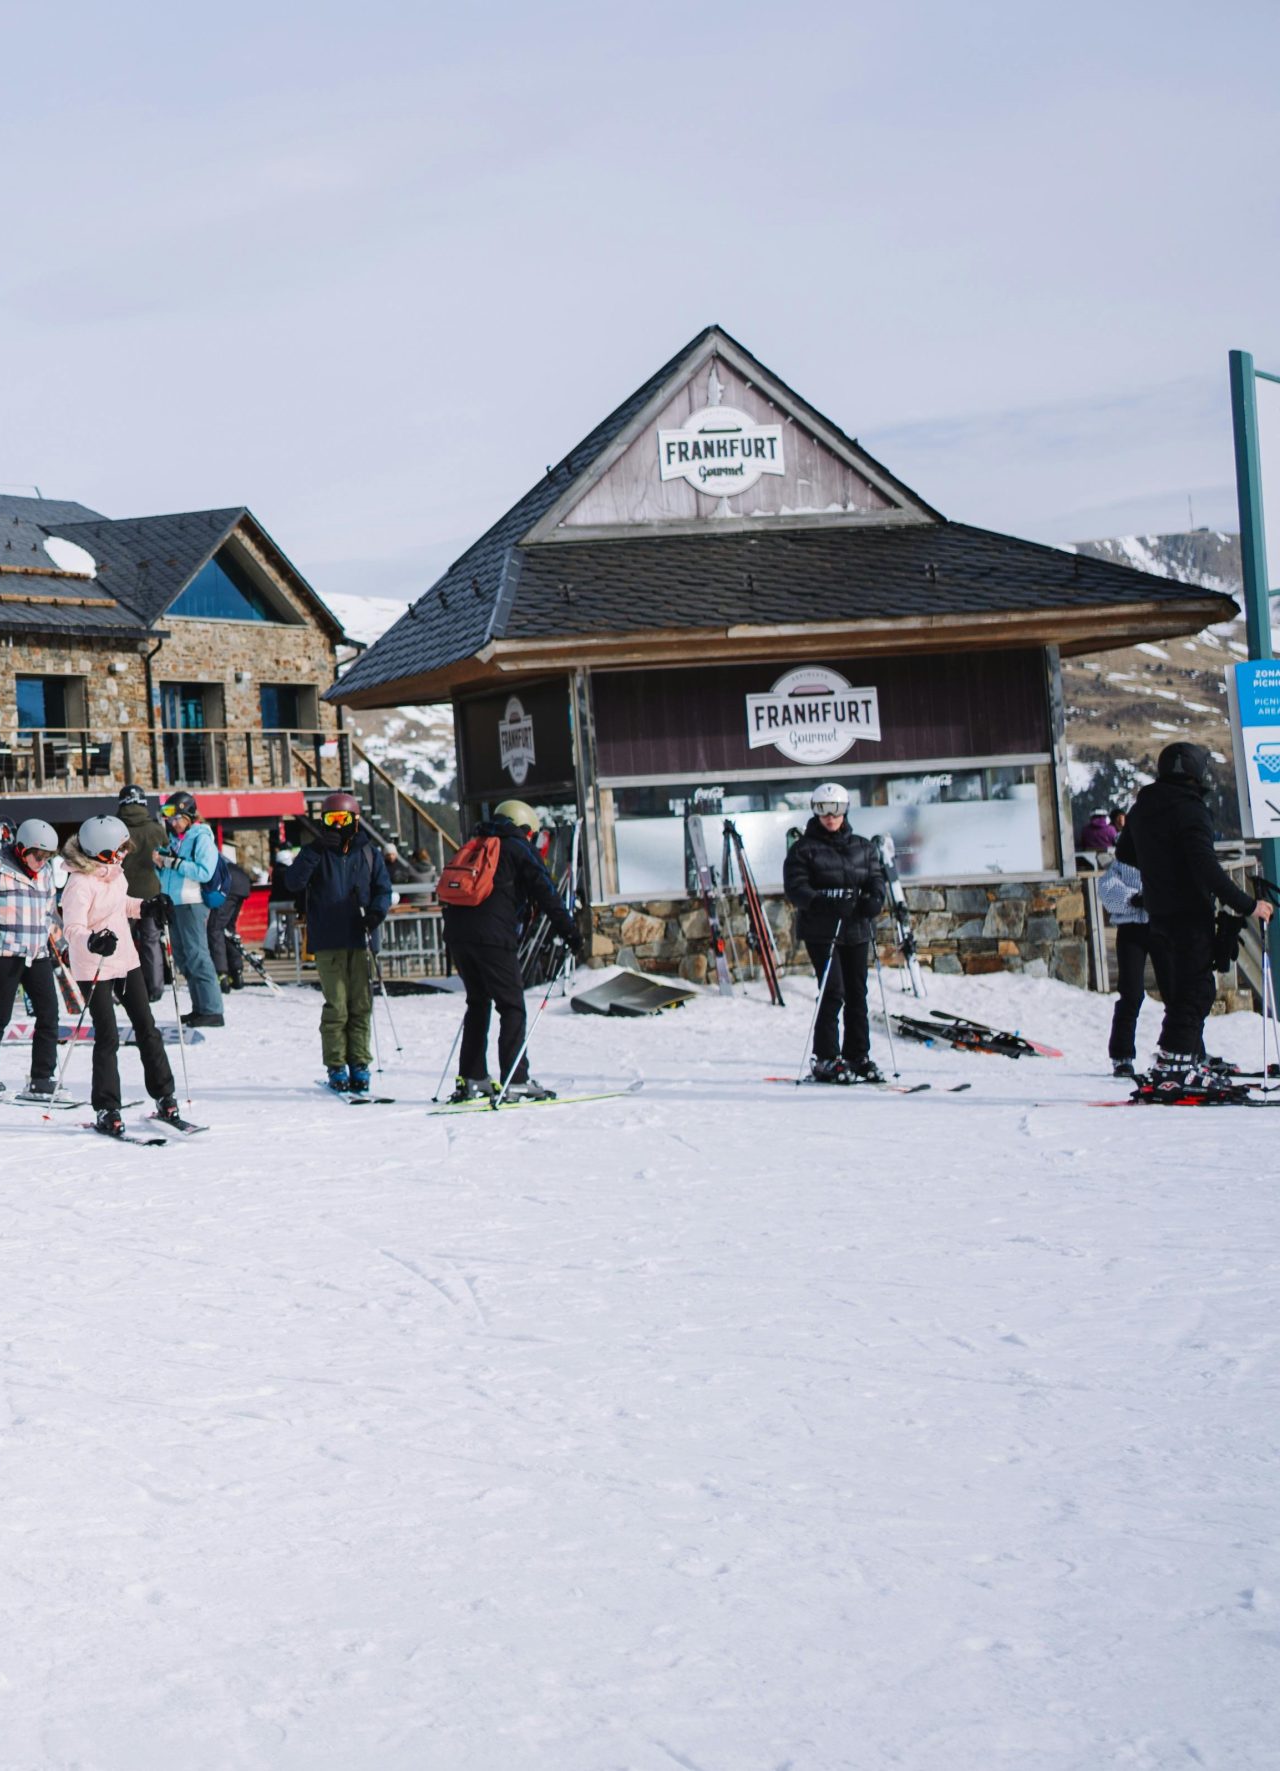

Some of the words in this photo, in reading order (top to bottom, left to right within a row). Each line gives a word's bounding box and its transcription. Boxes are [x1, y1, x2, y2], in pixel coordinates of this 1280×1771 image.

[666, 437, 777, 465] FRANKFURT
[698, 462, 744, 482] Gourmet
[1254, 697, 1280, 706] PICNI
[754, 700, 872, 731] FRANKFURT
[789, 727, 837, 750] Gourmet
